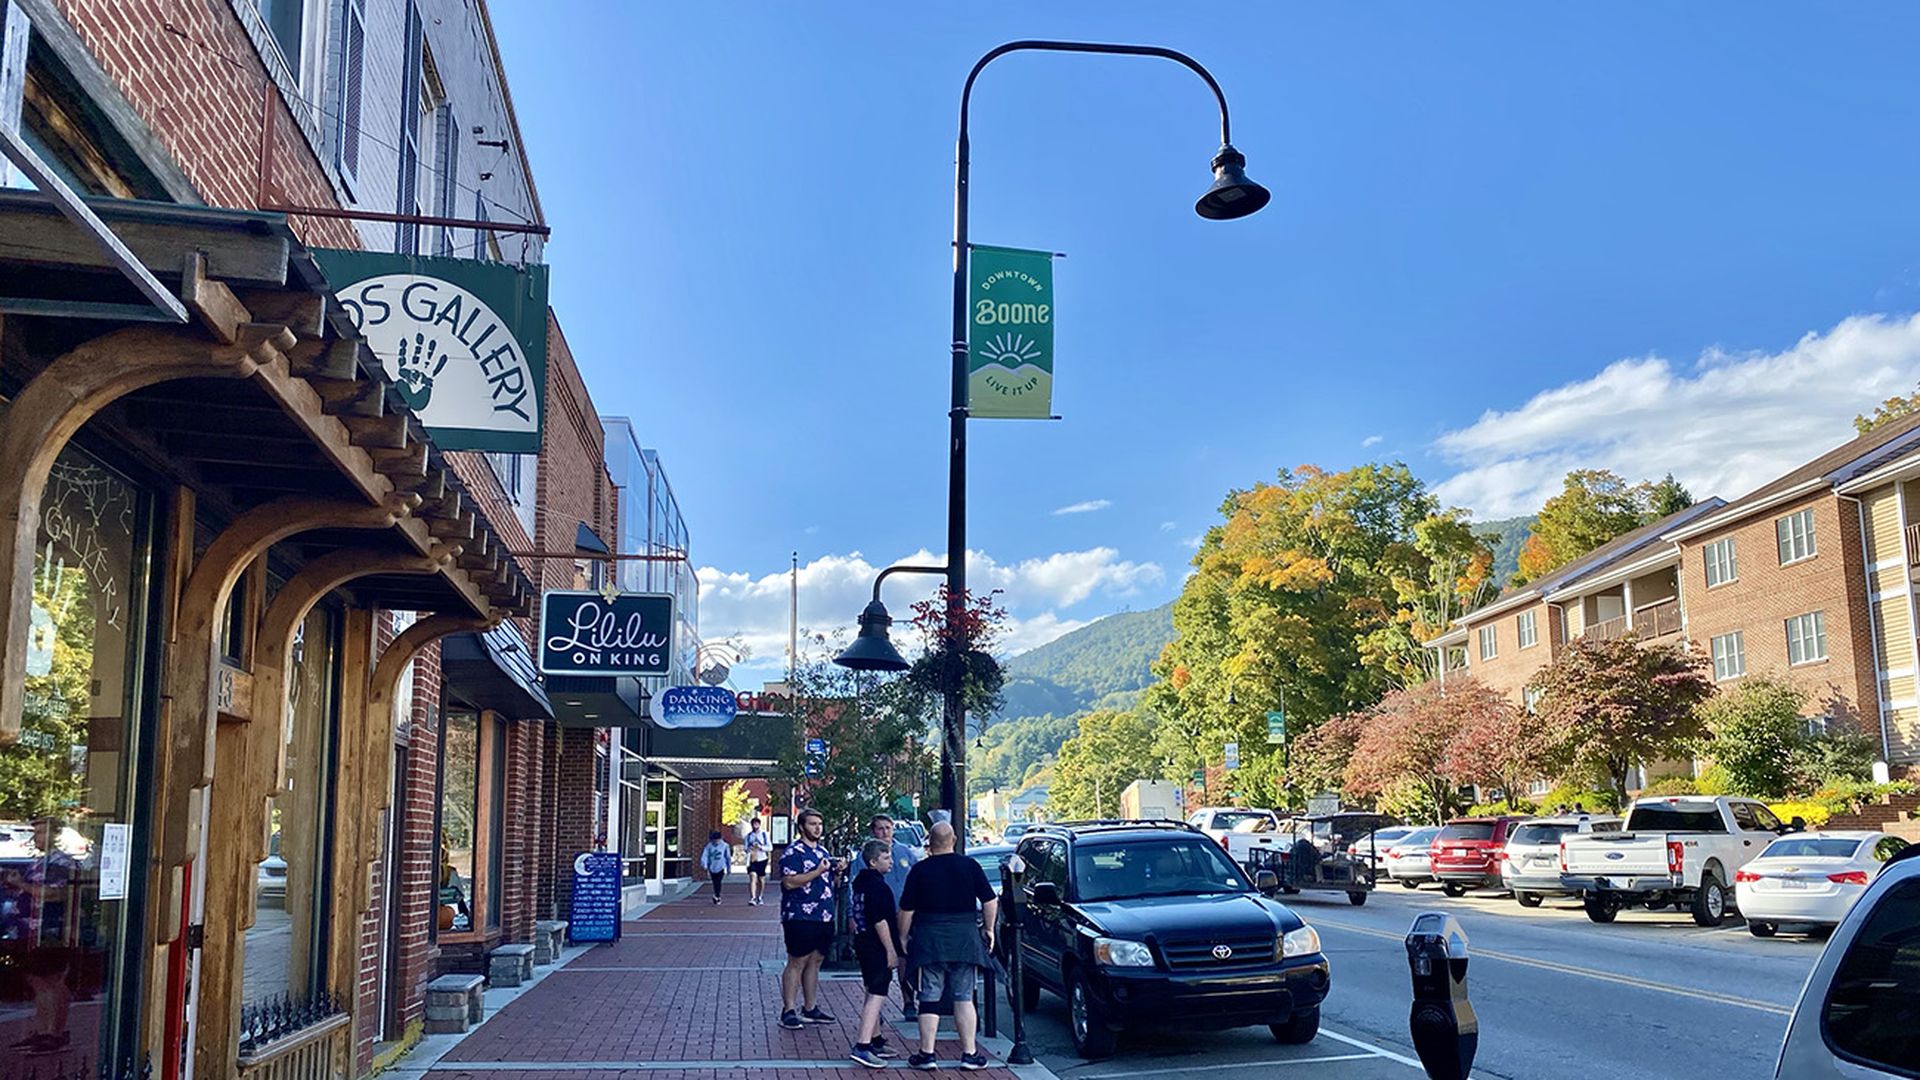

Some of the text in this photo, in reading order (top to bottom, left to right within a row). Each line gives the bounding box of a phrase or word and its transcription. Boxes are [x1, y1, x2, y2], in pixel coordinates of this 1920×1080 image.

[981, 270, 1043, 292] DOWNTOWN
[975, 299, 1050, 324] Boone
[401, 281, 530, 423] GALLERY
[985, 375, 1039, 396] LIVE IT UP
[547, 601, 667, 652] Lililu
[572, 652, 661, 665] ON KING
[668, 694, 731, 705] DANCING
[677, 704, 721, 714] MOON
